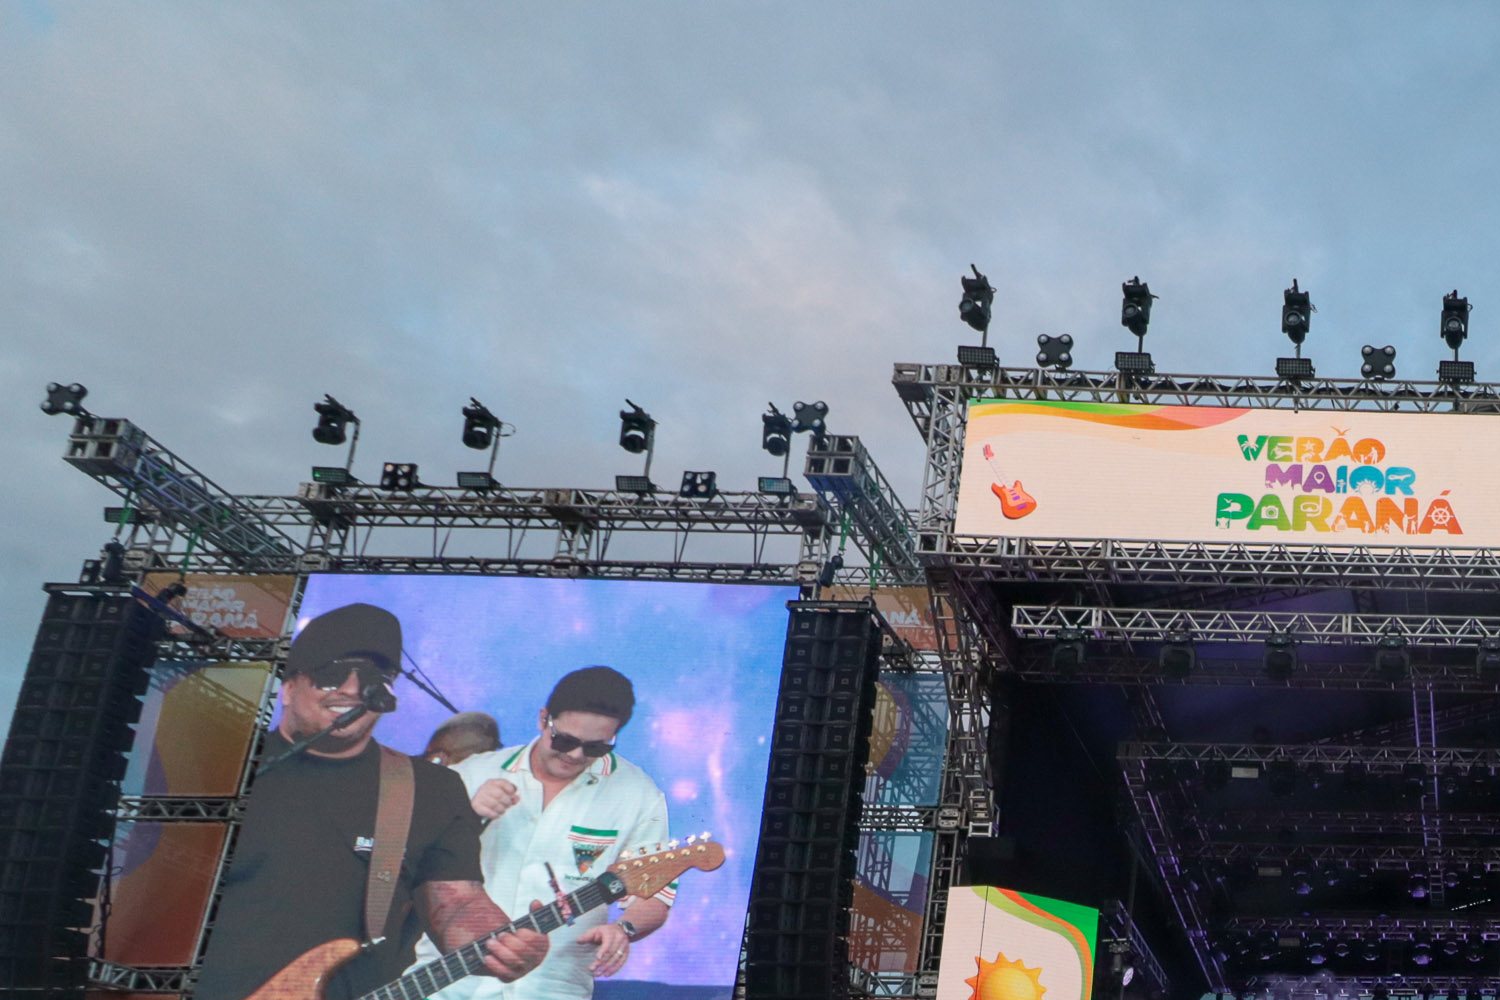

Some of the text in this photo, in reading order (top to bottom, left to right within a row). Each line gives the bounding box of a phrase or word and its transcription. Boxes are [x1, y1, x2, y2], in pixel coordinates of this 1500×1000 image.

[1236, 425, 1386, 464] VERÃO
[1265, 462, 1416, 496] MAIOR
[1215, 490, 1463, 535] PARANÁ
